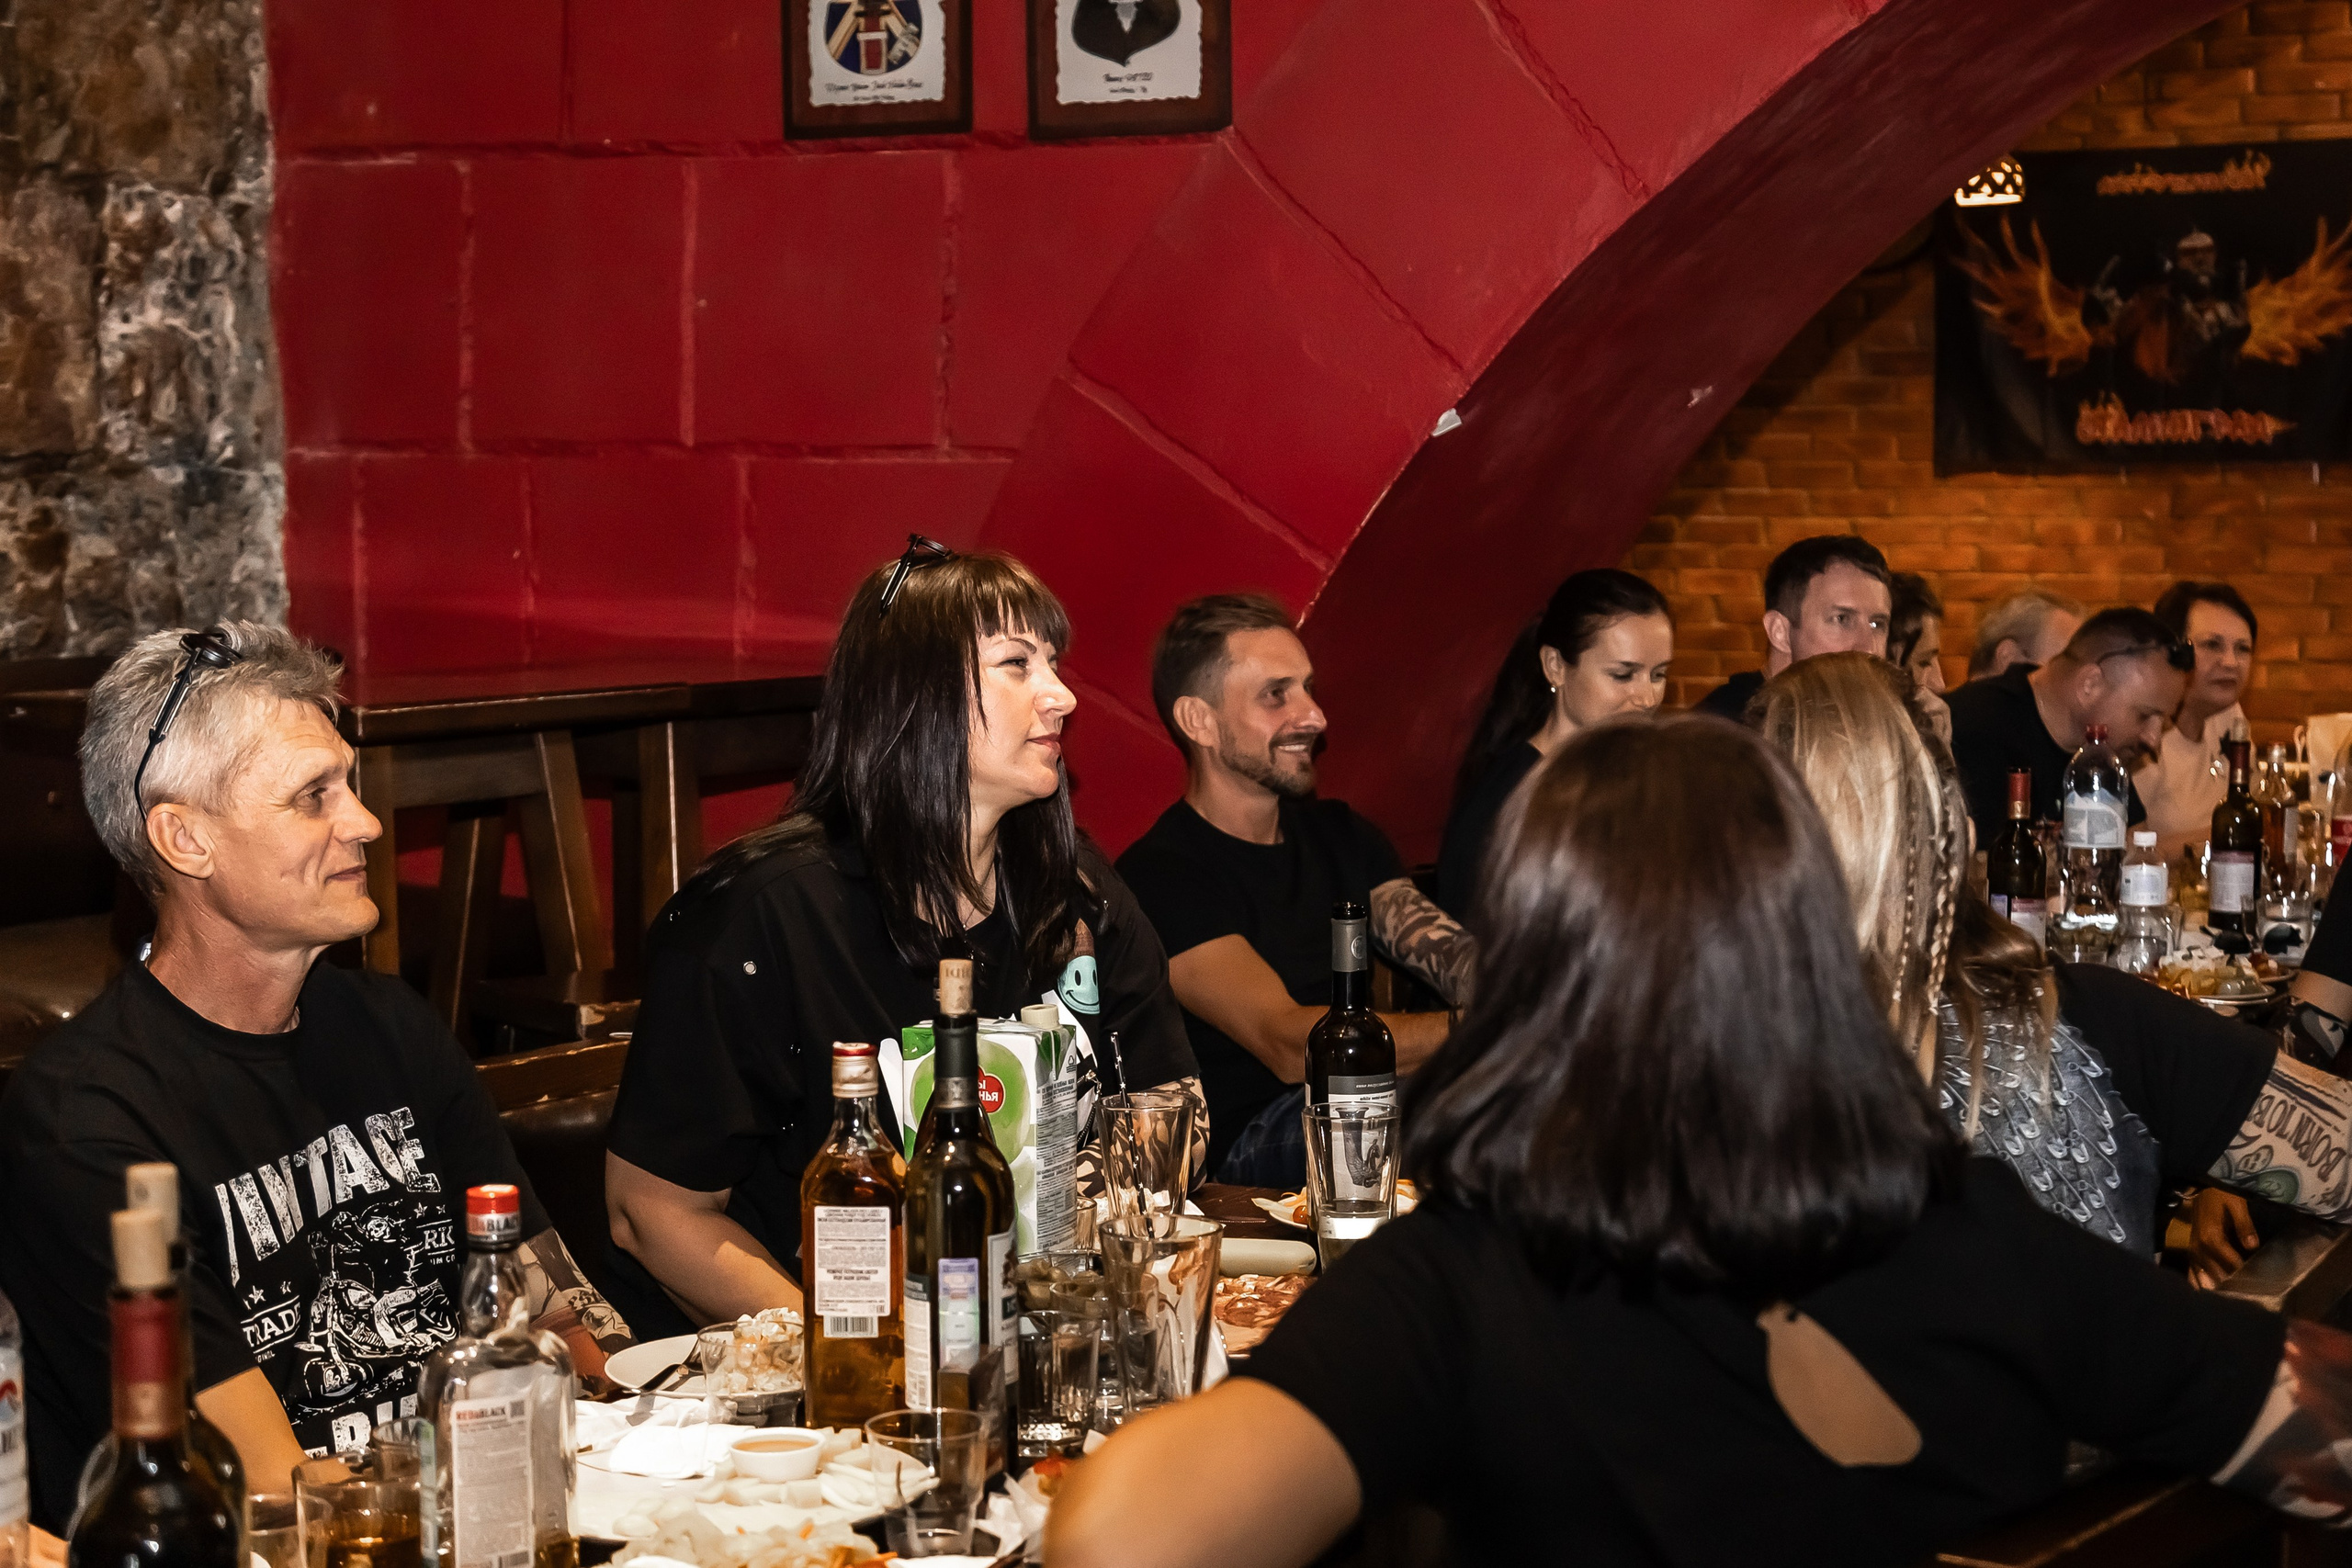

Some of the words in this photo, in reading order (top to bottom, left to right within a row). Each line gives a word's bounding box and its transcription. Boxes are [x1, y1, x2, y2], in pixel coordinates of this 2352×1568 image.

[2266, 1100, 2297, 1140] TO
[2288, 1112, 2347, 1183] BORN
[242, 1301, 301, 1348] TRADE
